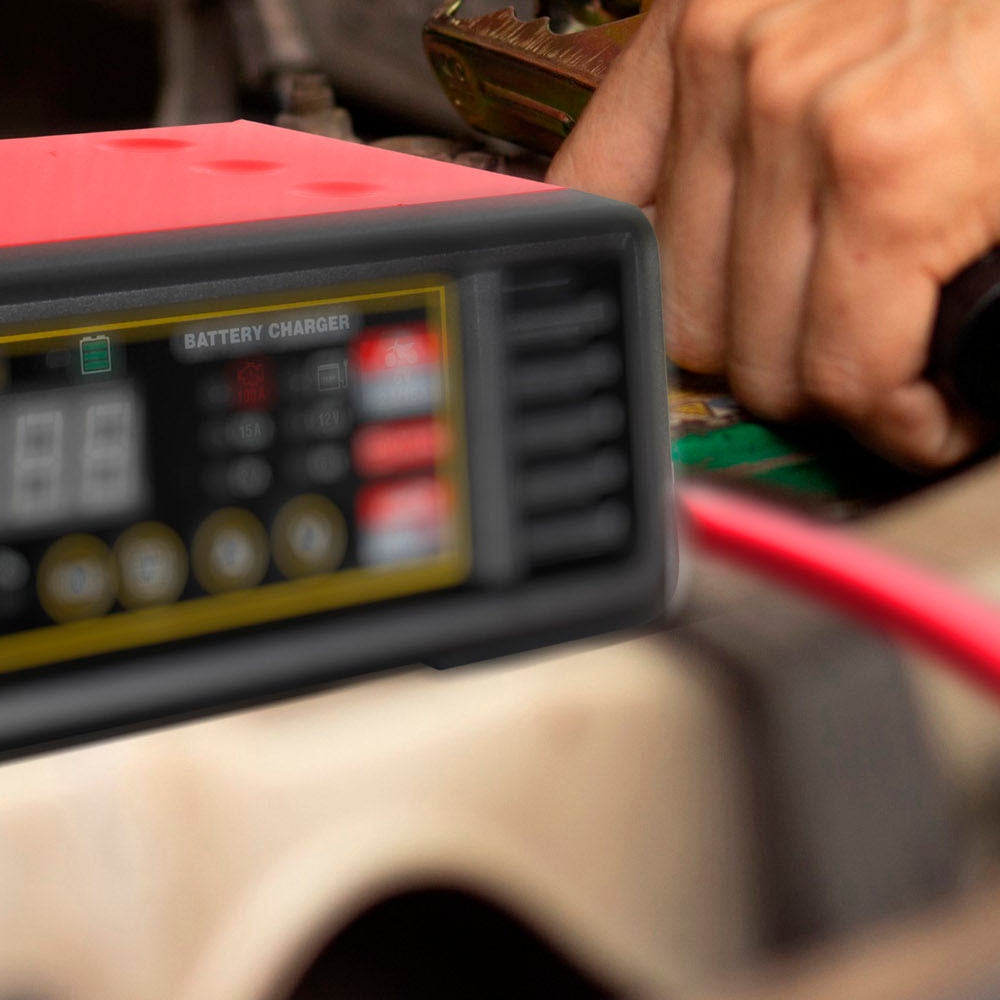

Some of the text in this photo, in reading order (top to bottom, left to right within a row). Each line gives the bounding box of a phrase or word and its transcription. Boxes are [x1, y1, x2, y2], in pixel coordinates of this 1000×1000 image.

[184, 314, 351, 350] BATTERY CHARGER
[239, 423, 262, 440] 15A
